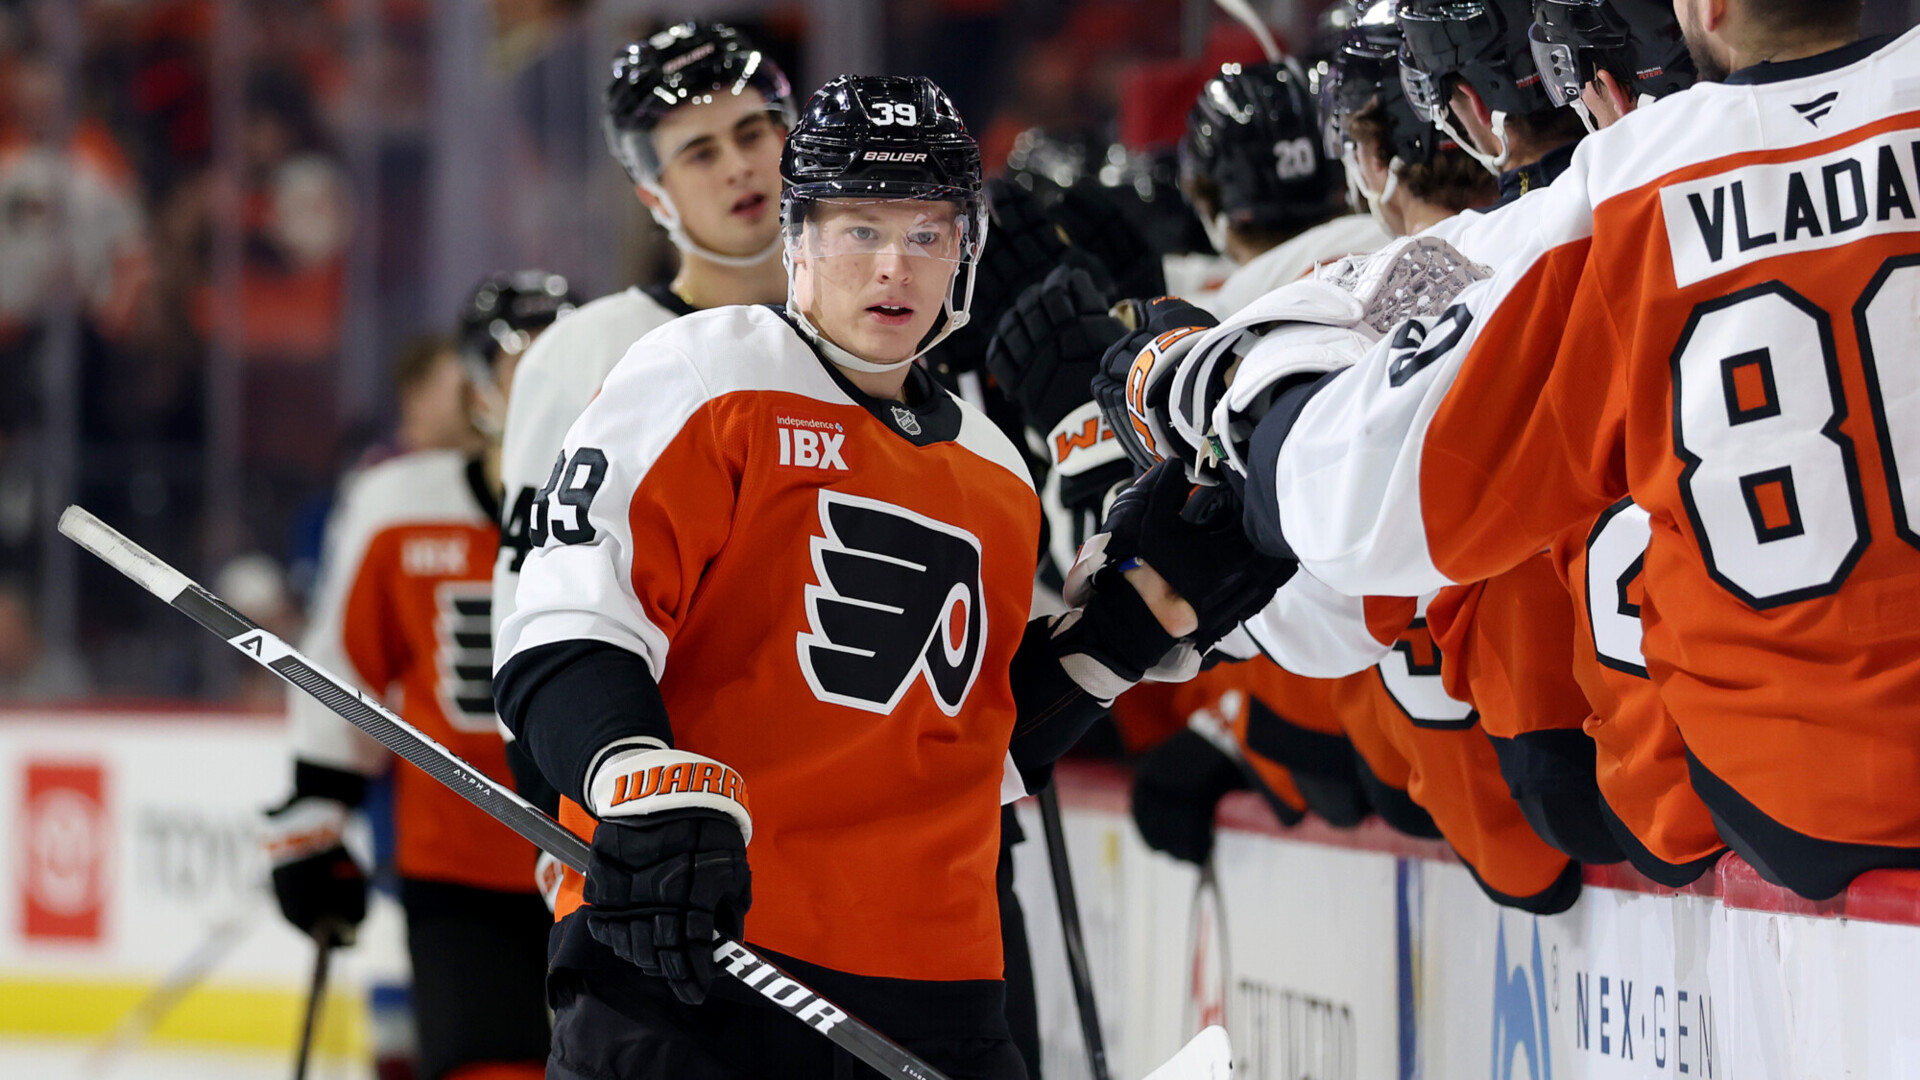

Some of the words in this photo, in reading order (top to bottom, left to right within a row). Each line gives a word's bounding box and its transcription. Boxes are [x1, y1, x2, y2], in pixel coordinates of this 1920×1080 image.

[871, 103, 917, 127] 39
[863, 151, 928, 163] BAUER
[1273, 137, 1316, 179] 20
[1687, 141, 1920, 263] VLADA
[776, 415, 834, 430] Independence
[778, 428, 849, 470] IBX
[453, 768, 491, 796] ALPHA
[713, 929, 848, 1036] RIOR
